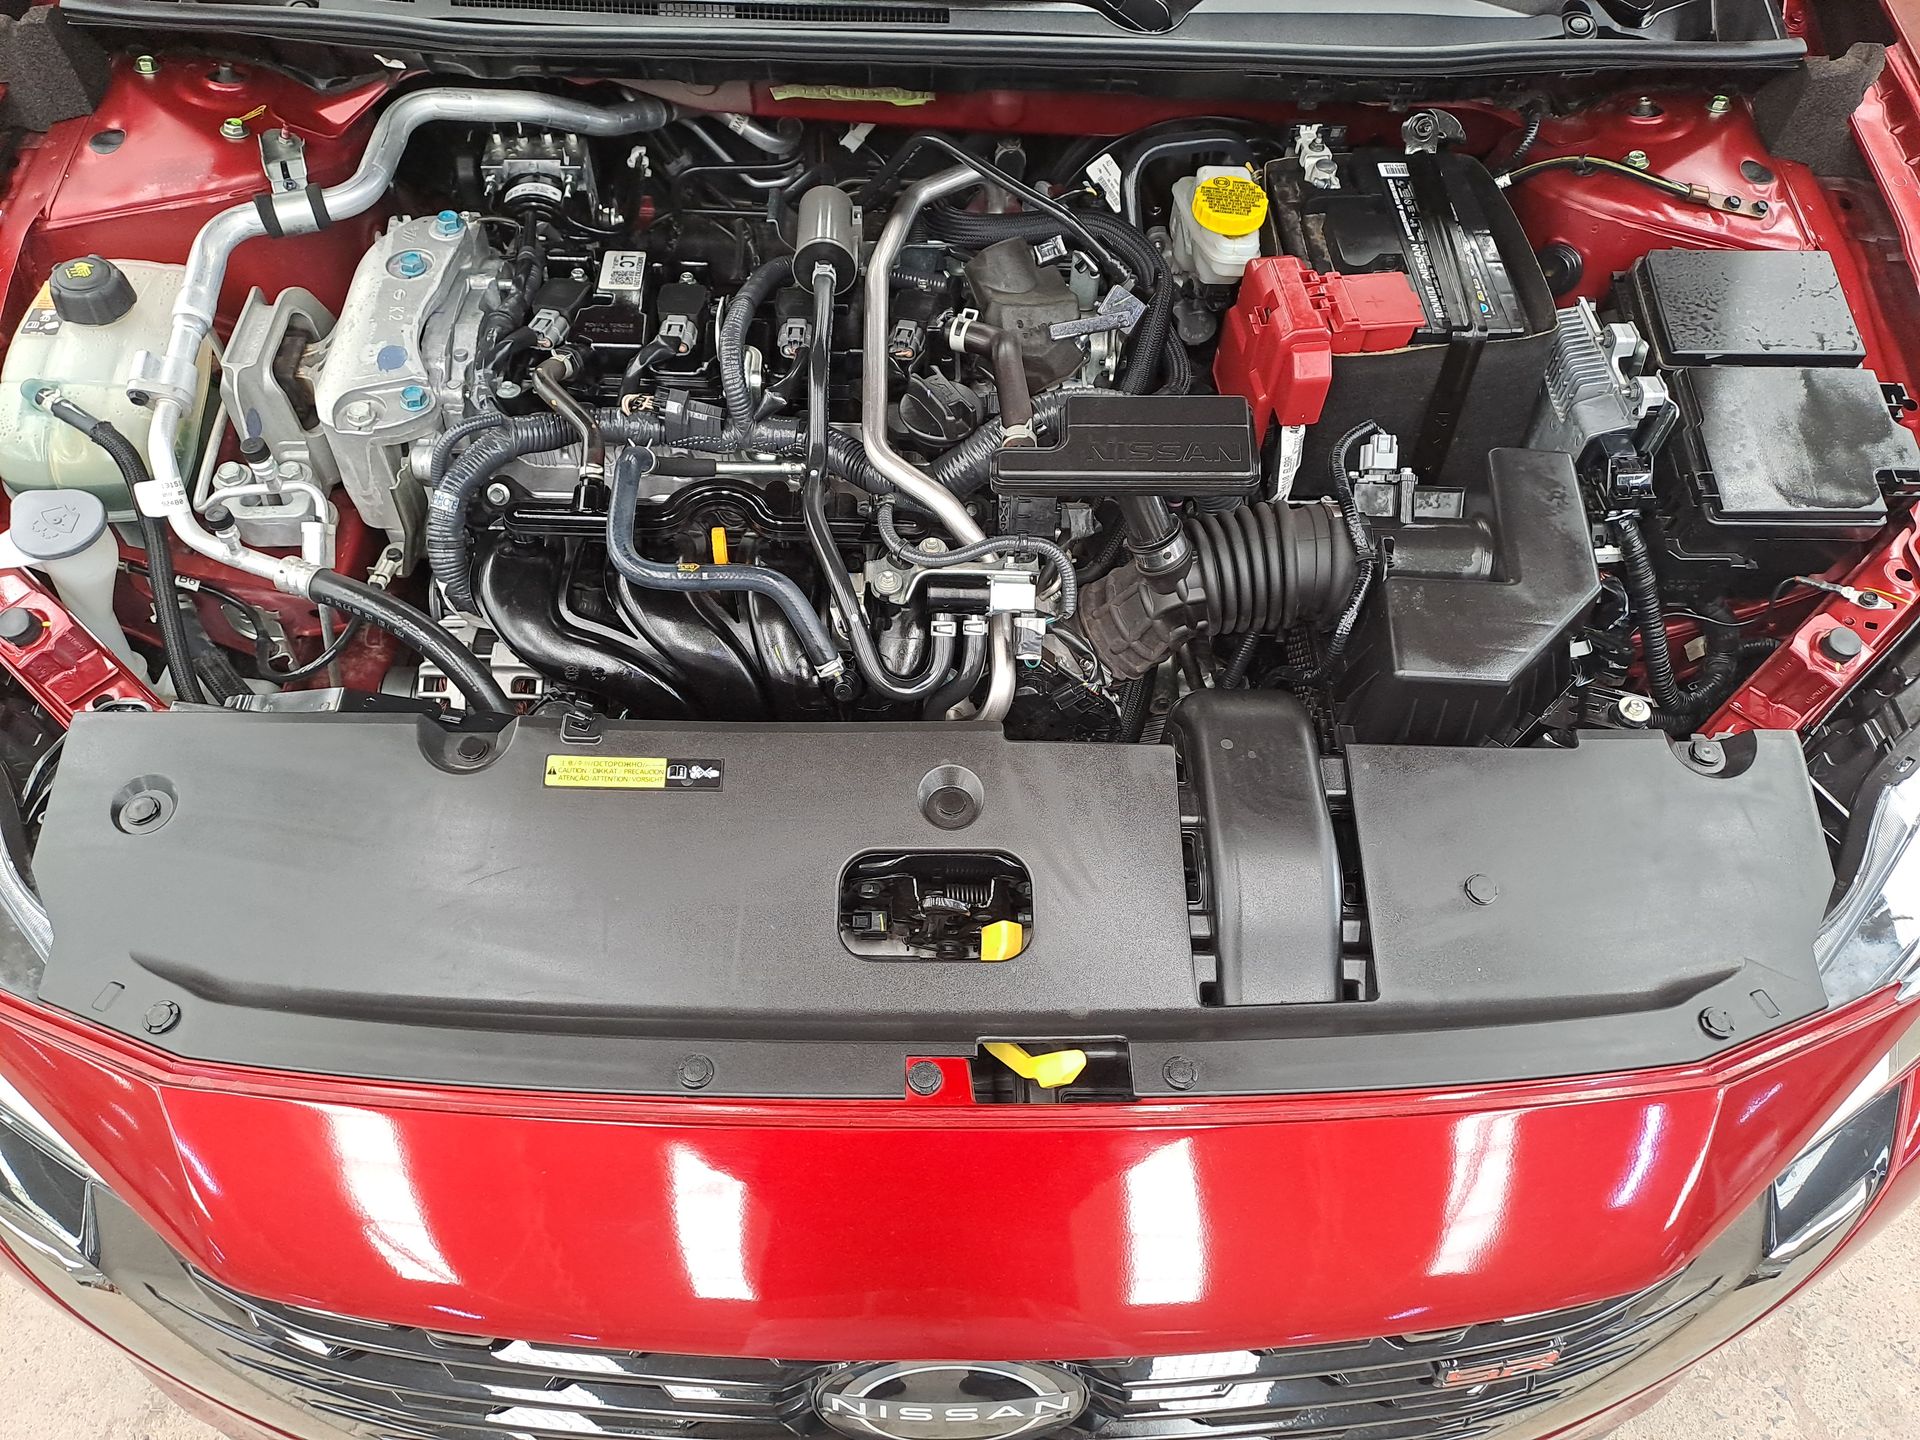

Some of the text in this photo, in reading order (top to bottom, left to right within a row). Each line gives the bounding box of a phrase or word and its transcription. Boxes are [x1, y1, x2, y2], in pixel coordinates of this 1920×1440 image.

[619, 255, 637, 268] LC
[1410, 243, 1432, 283] NISSAN
[1424, 285, 1445, 320] RENAULT
[1086, 440, 1242, 463] NISSAN
[831, 1396, 1070, 1422] NISSAN
